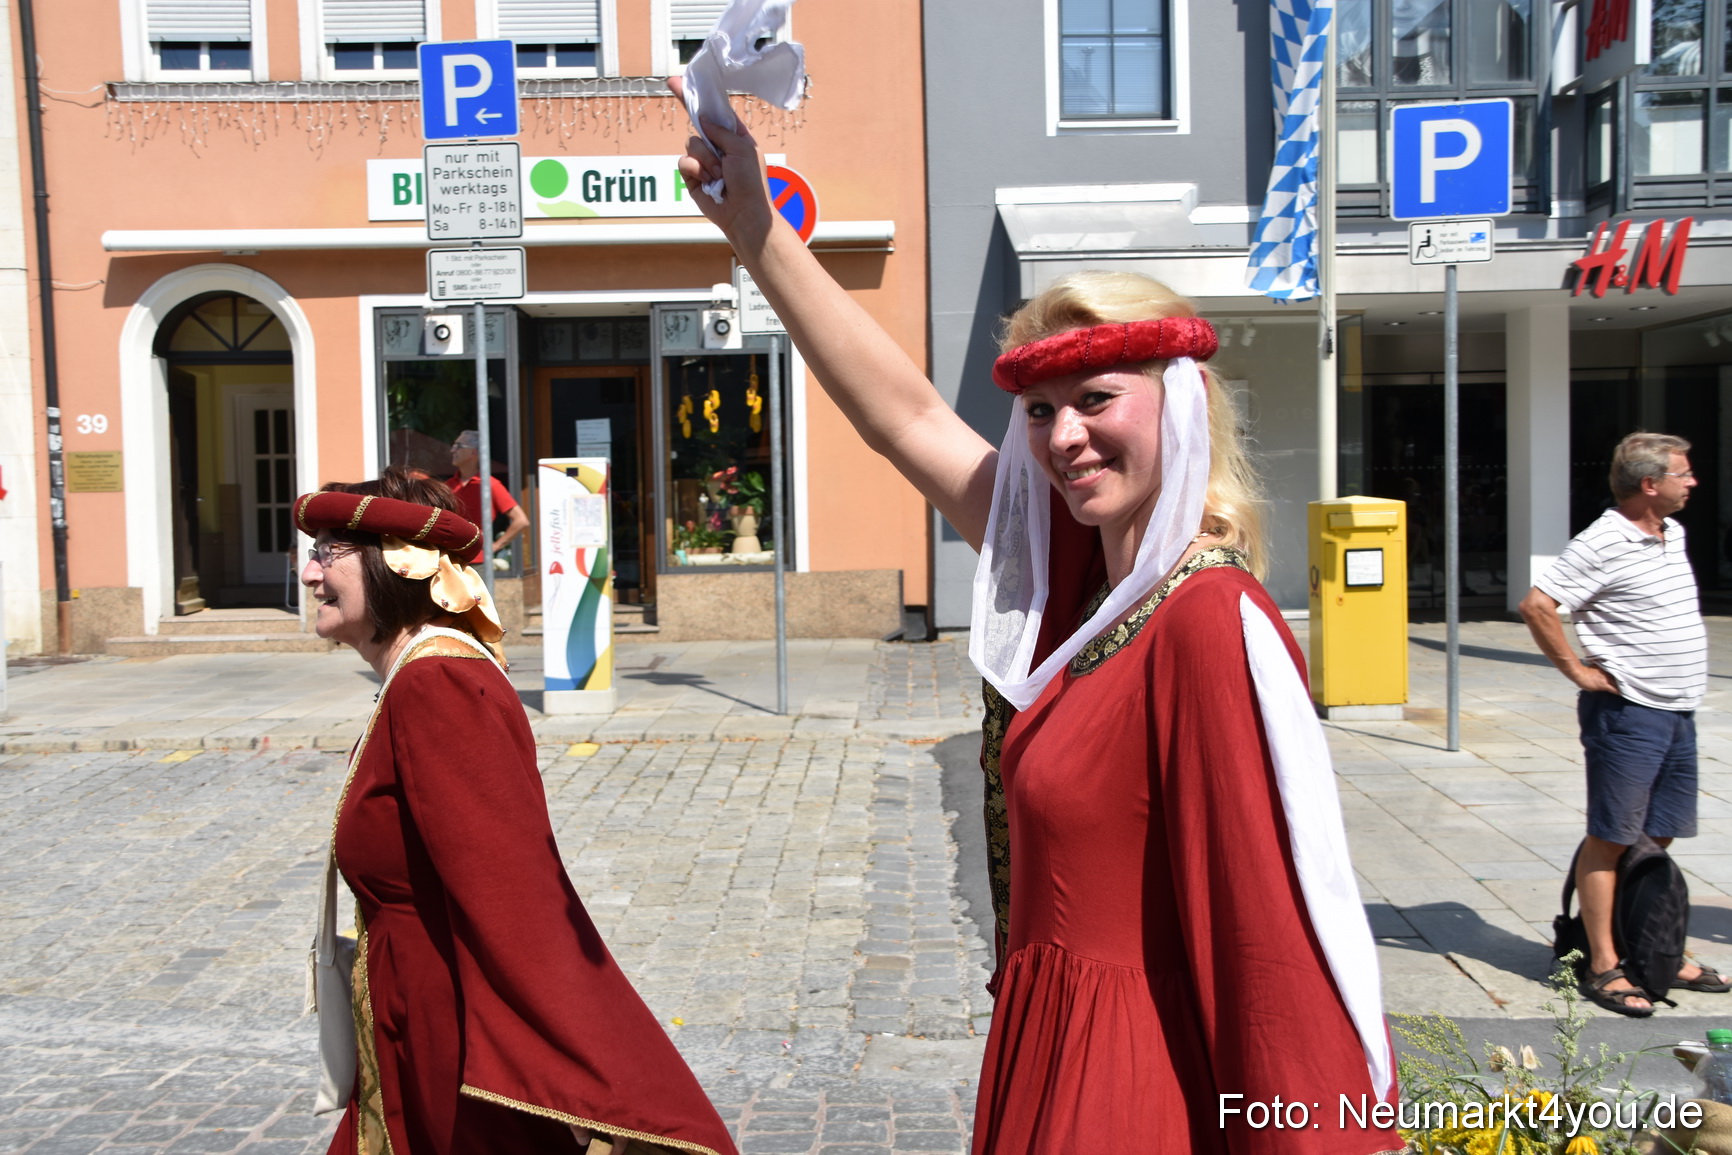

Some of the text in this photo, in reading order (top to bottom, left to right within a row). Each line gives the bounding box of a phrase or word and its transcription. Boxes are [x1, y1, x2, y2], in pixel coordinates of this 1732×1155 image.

[442, 54, 493, 126] P
[445, 150, 500, 163] nur mit
[1420, 118, 1482, 204] P
[433, 166, 513, 180] Parkschein
[440, 183, 508, 197] werktags
[582, 169, 657, 202] Grün
[432, 202, 472, 215] Mo-Fr
[433, 220, 449, 231] Sa
[1573, 216, 1694, 298] H&M
[76, 413, 108, 435] 39
